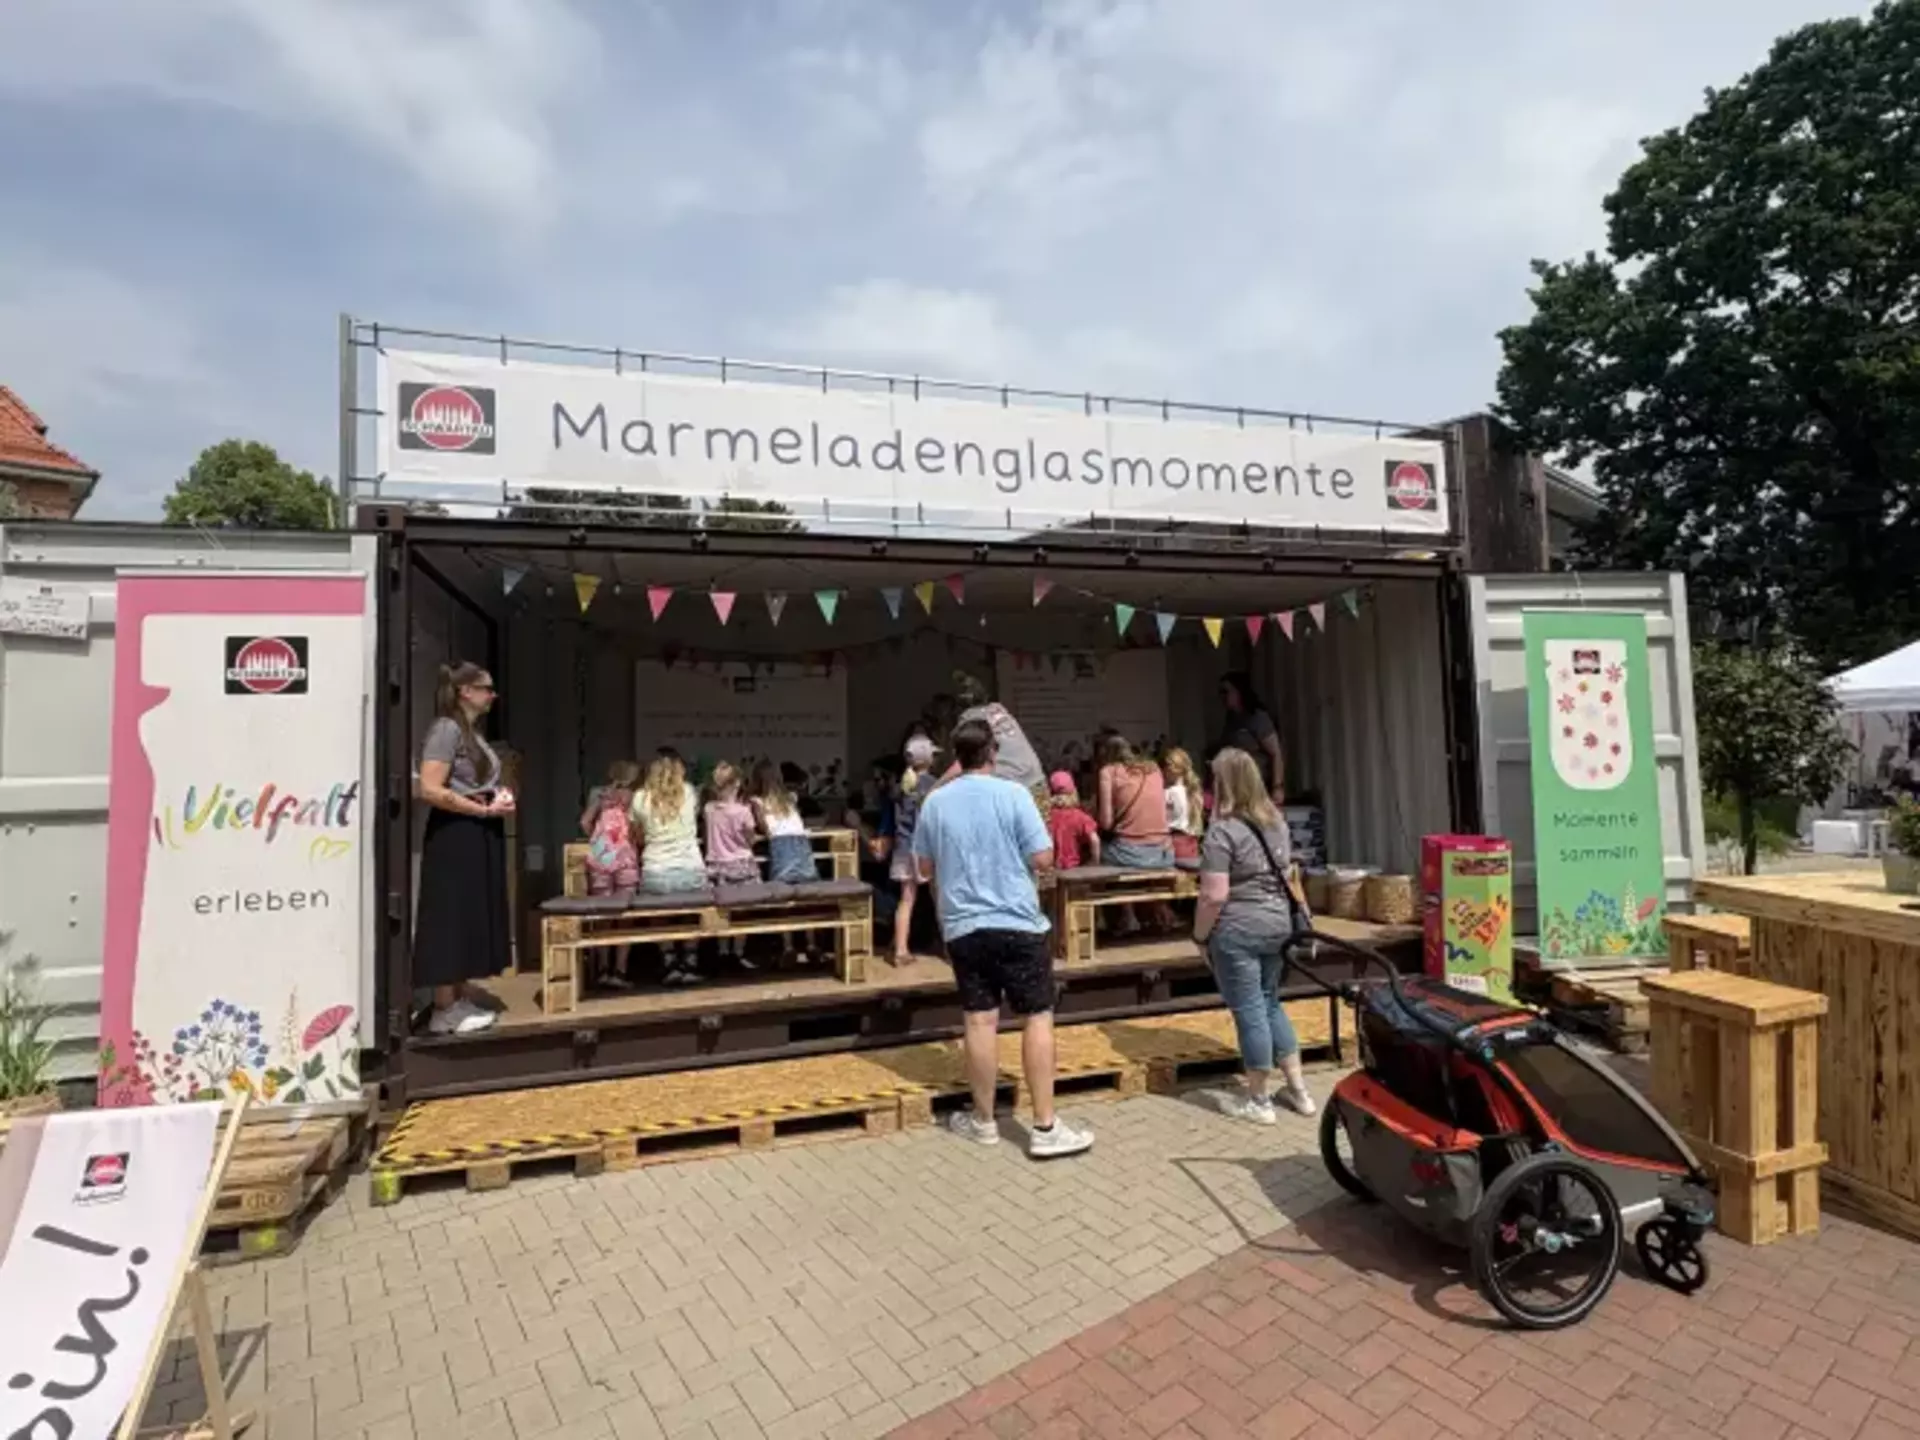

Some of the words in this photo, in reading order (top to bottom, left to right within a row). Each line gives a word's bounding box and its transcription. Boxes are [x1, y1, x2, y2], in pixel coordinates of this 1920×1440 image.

[553, 402, 1355, 499] Marmeladenglasmomente
[184, 781, 359, 843] Vielfalt
[1553, 811, 1639, 828] Momente
[1560, 845, 1638, 862] sammeln
[194, 889, 329, 914] erleben
